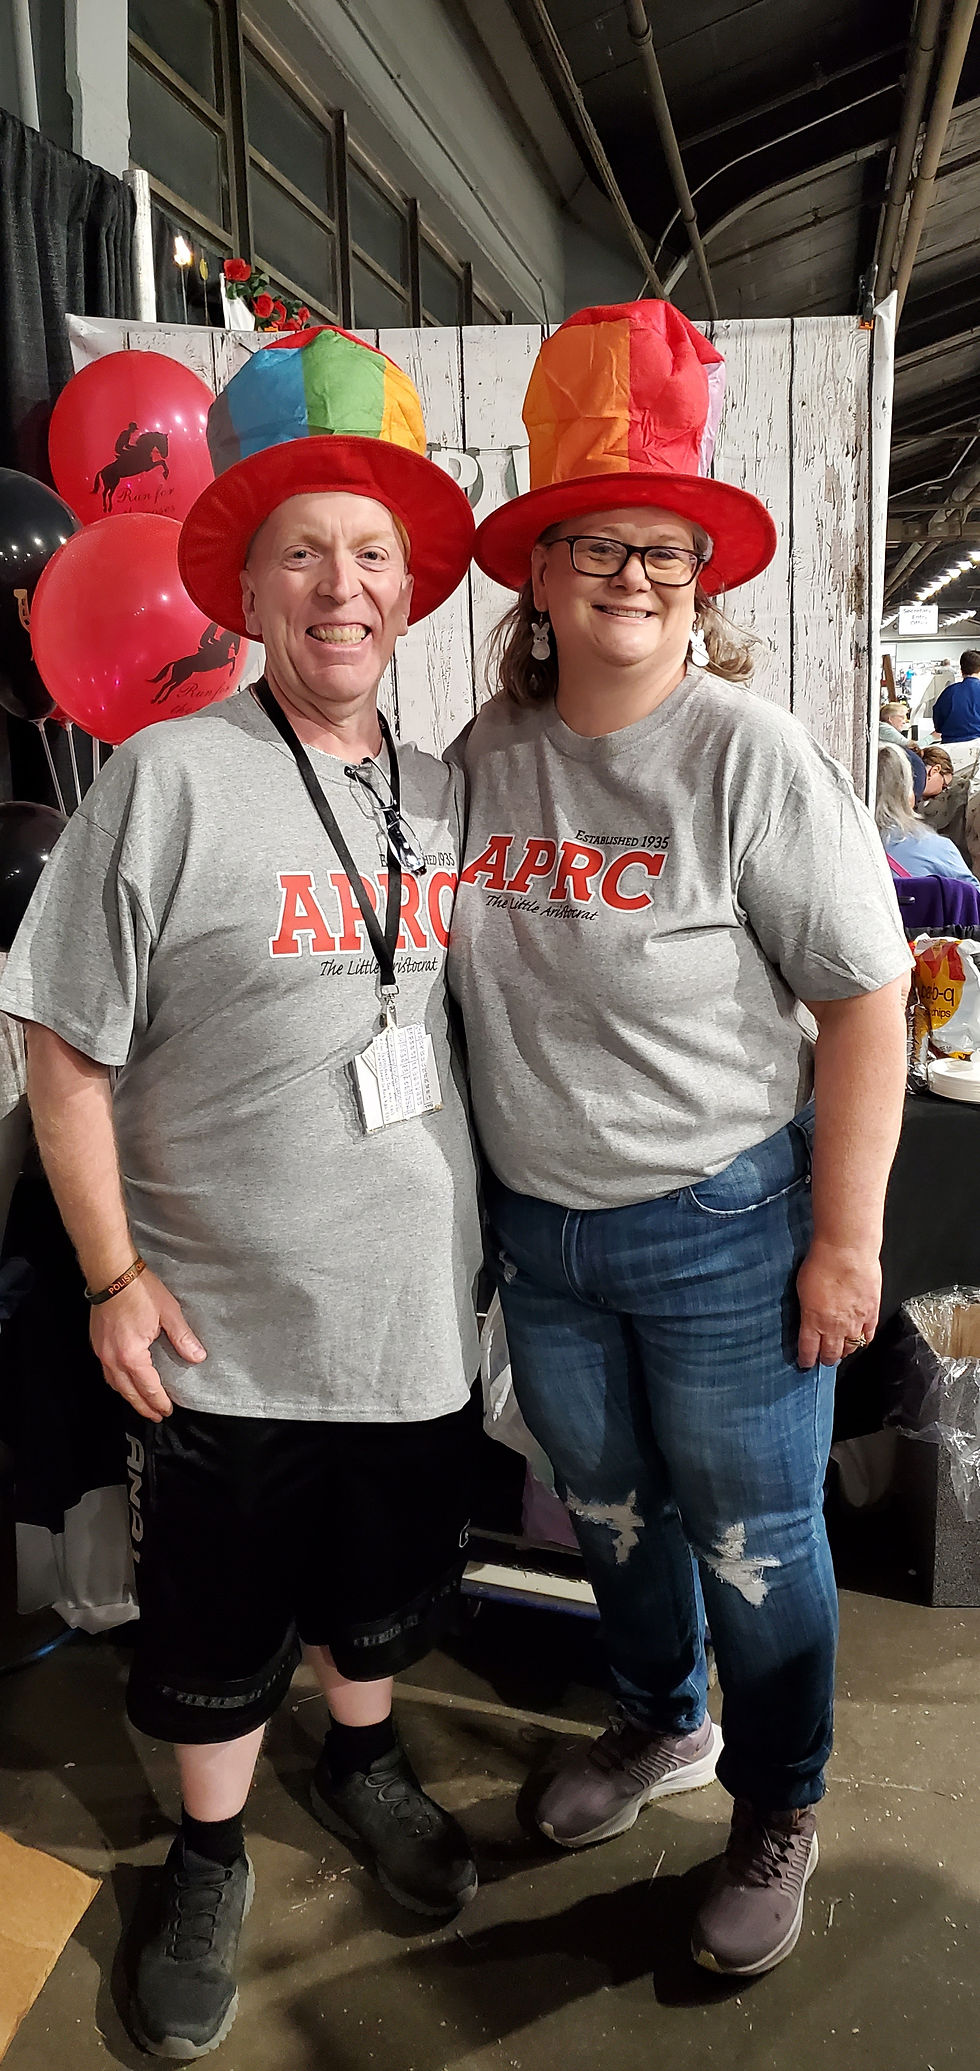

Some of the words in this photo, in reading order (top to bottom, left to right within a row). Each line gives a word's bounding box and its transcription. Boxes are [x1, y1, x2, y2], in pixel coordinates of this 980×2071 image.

[116, 487, 151, 503] Run
[177, 682, 212, 698] Run
[575, 829, 639, 847] ESTABLISHED
[640, 835, 670, 850] 1935
[437, 852, 456, 867] 1935
[460, 834, 669, 914] APRC
[486, 895, 508, 910] The
[509, 898, 540, 914] Little
[540, 904, 600, 921] Aristocrat
[320, 958, 344, 976] The
[347, 956, 381, 976] Little
[392, 955, 439, 975] ristocrat
[108, 1270, 136, 1295] POLISH
